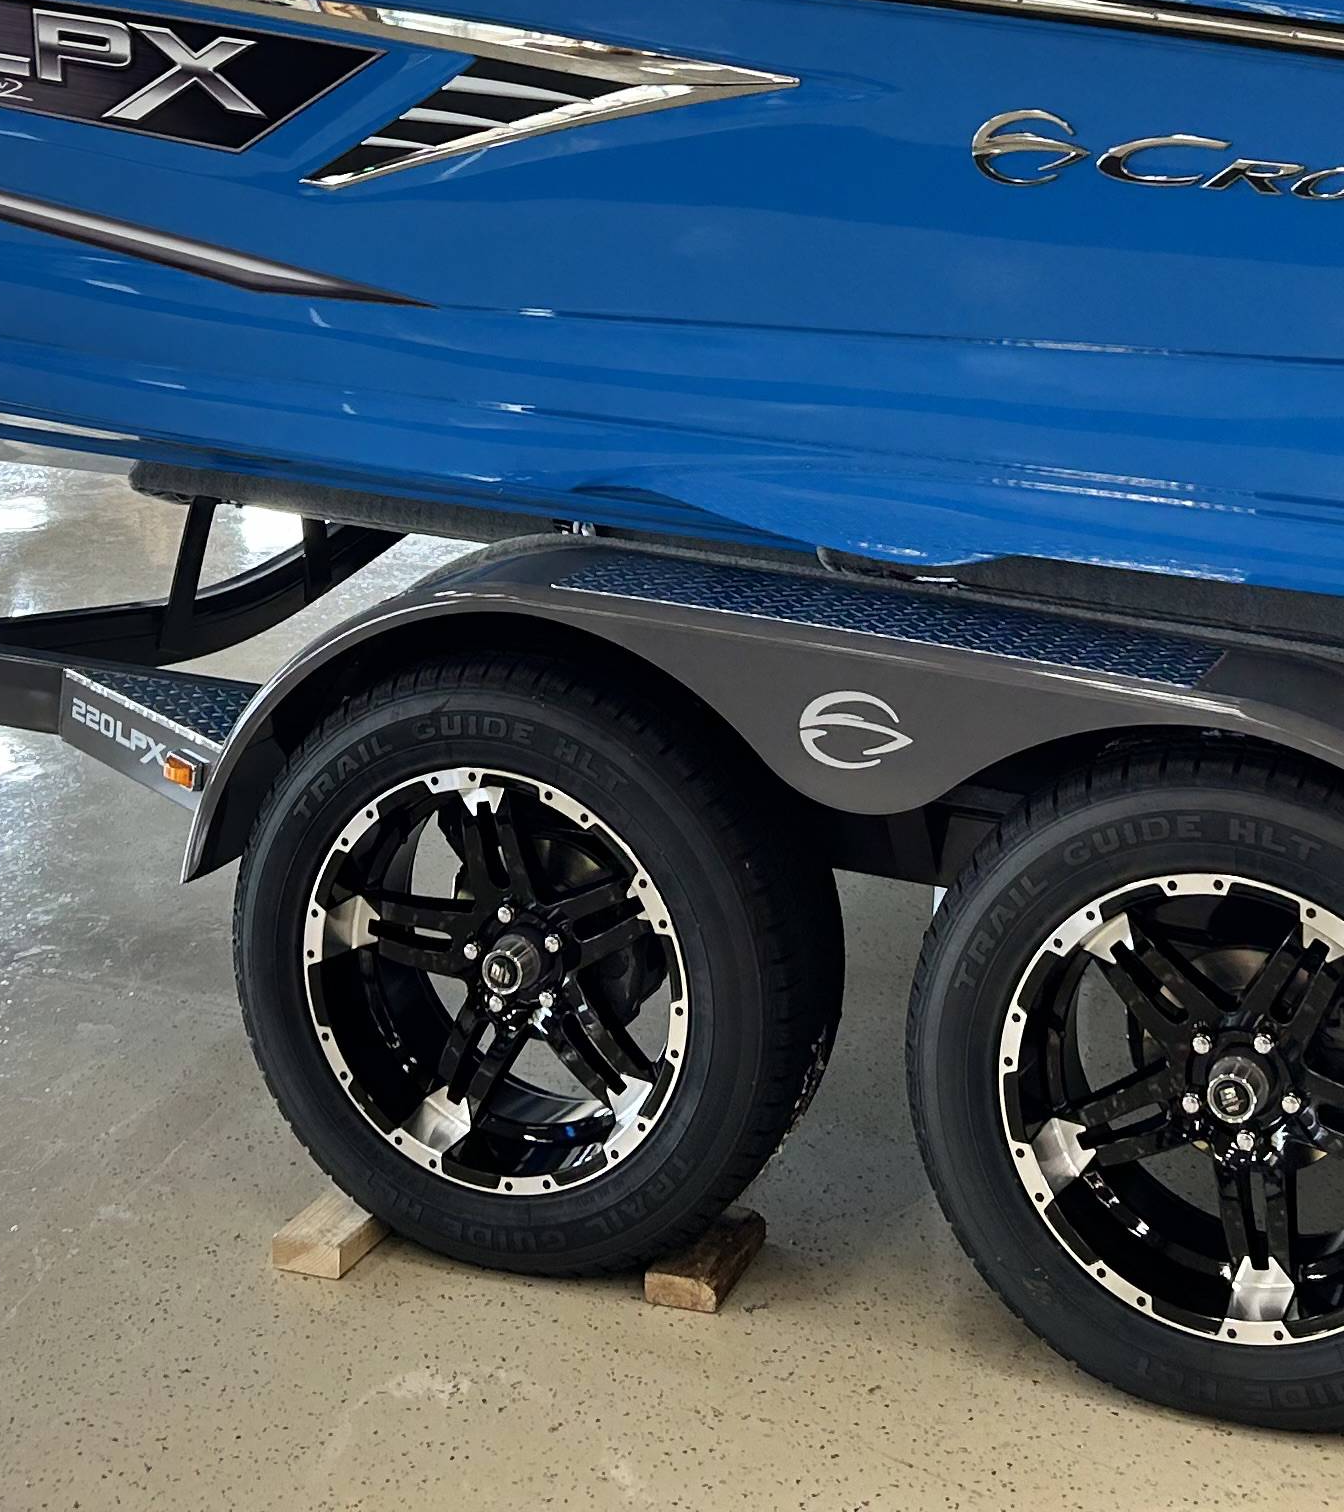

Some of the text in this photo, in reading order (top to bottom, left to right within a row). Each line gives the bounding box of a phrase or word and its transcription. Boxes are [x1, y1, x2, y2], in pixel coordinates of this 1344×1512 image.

[71, 697, 166, 767] 220LPX
[293, 714, 631, 818] TRAIL GUIDE HLT
[958, 814, 1323, 989] TRAIL GUIDE HLT
